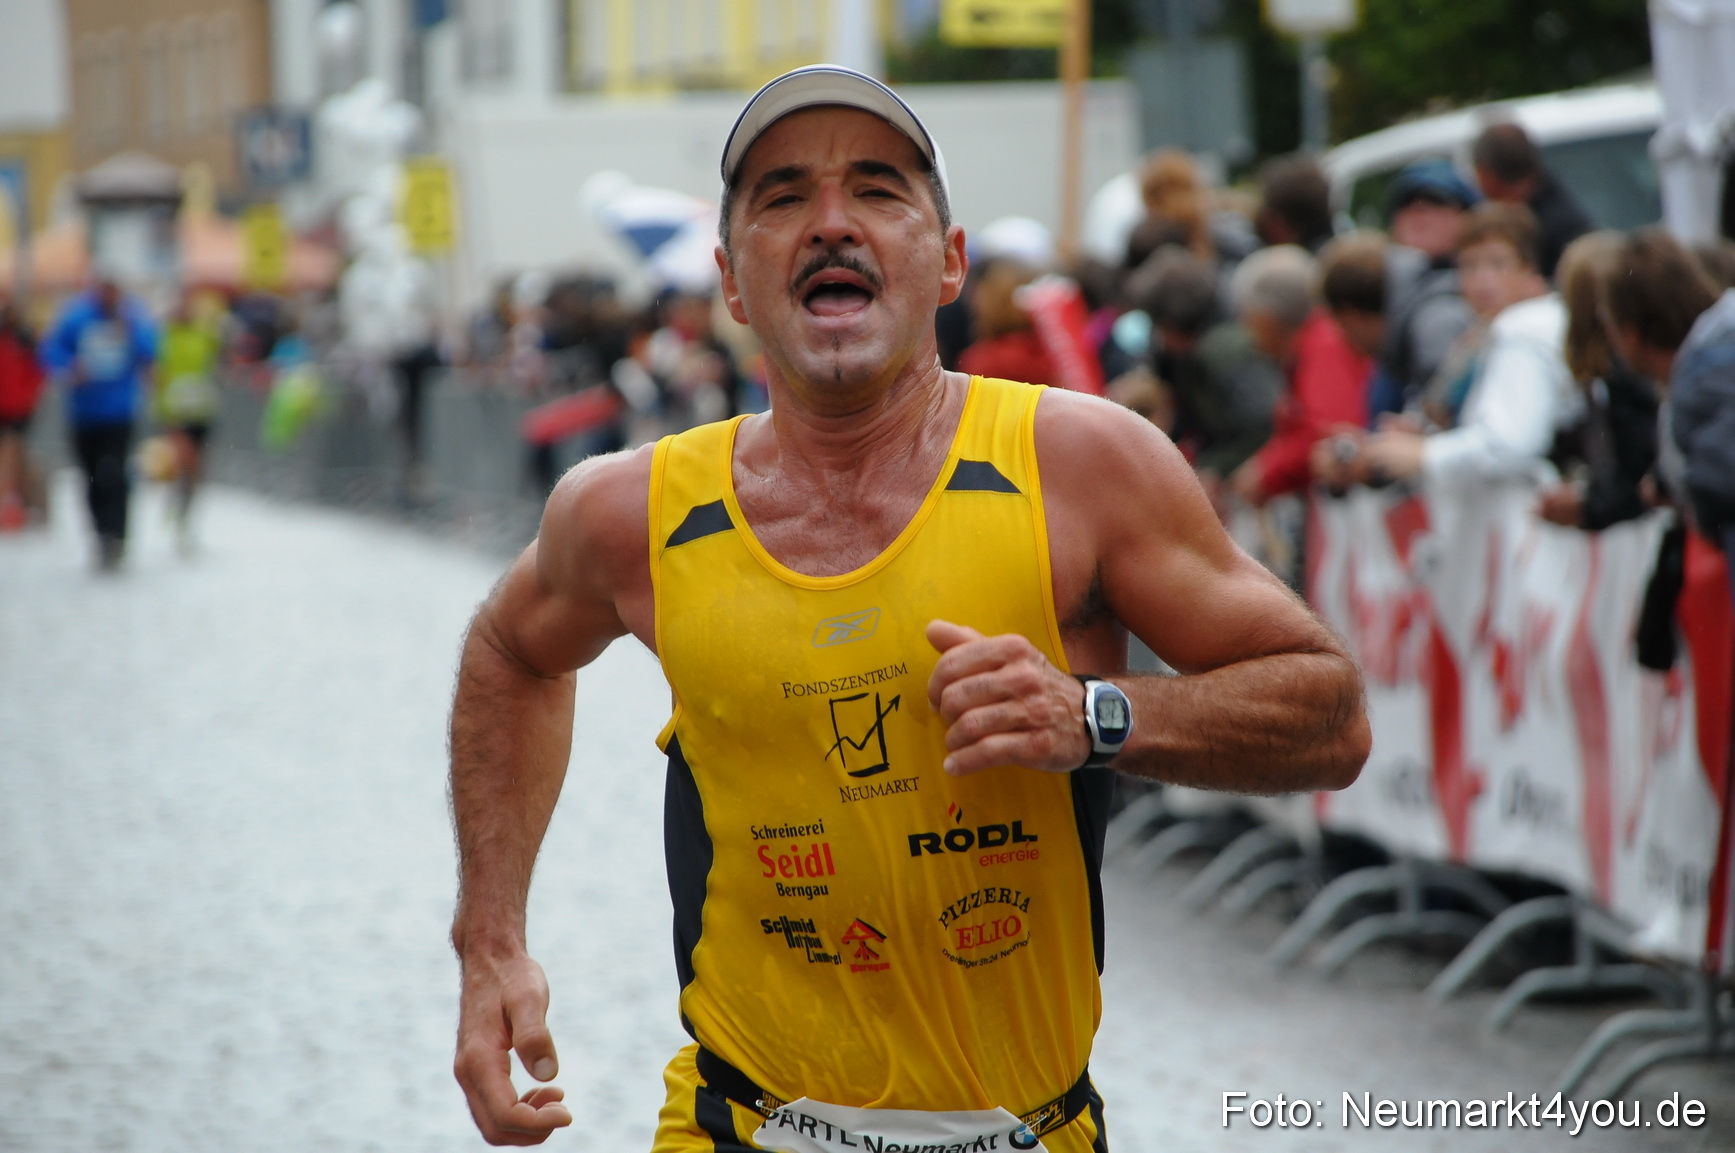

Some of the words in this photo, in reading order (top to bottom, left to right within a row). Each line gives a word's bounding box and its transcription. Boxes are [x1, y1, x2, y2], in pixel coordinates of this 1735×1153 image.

[782, 662, 908, 698] FONDSZENTRUM
[839, 777, 920, 803] NEUMARKT
[750, 819, 825, 841] Schreinerei
[757, 842, 836, 878] Seidl
[776, 882, 829, 900] Berngau
[939, 887, 1030, 931] PIZZERIA
[955, 915, 1022, 950] ELIO
